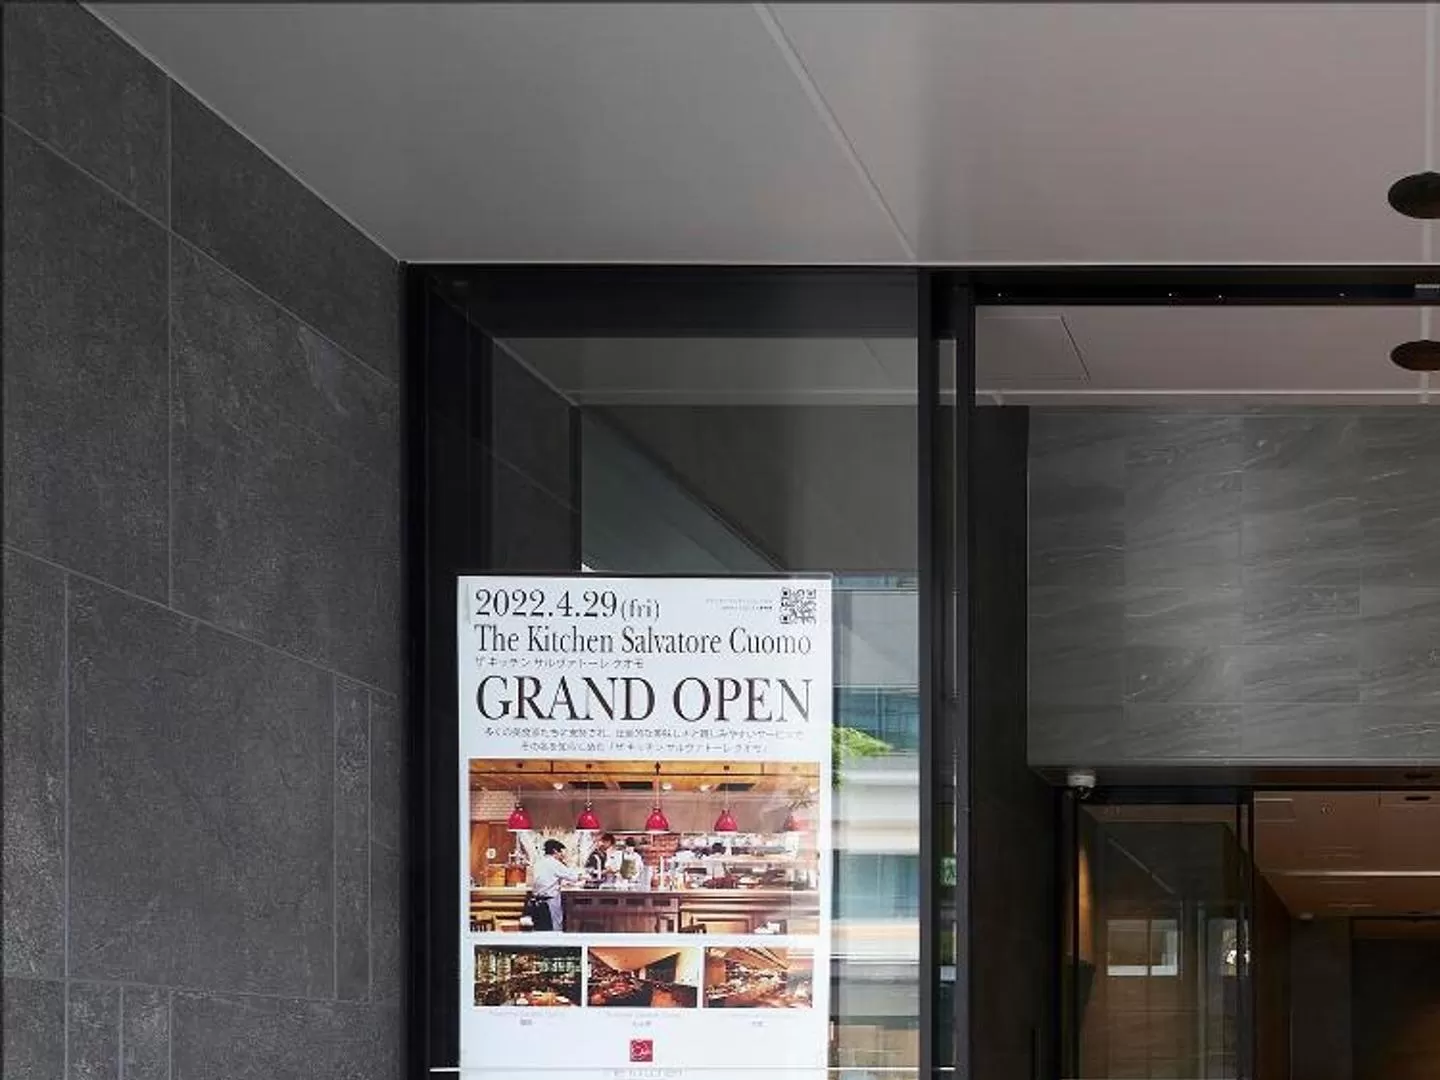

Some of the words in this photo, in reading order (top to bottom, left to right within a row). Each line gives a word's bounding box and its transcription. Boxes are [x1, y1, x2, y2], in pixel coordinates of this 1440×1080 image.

[474, 624, 519, 651] The
[527, 625, 613, 652] Kitchen
[621, 625, 722, 654] Salvatore
[729, 626, 812, 655] Cuomo
[476, 675, 655, 721] GRAND
[672, 676, 812, 723] OPEN
